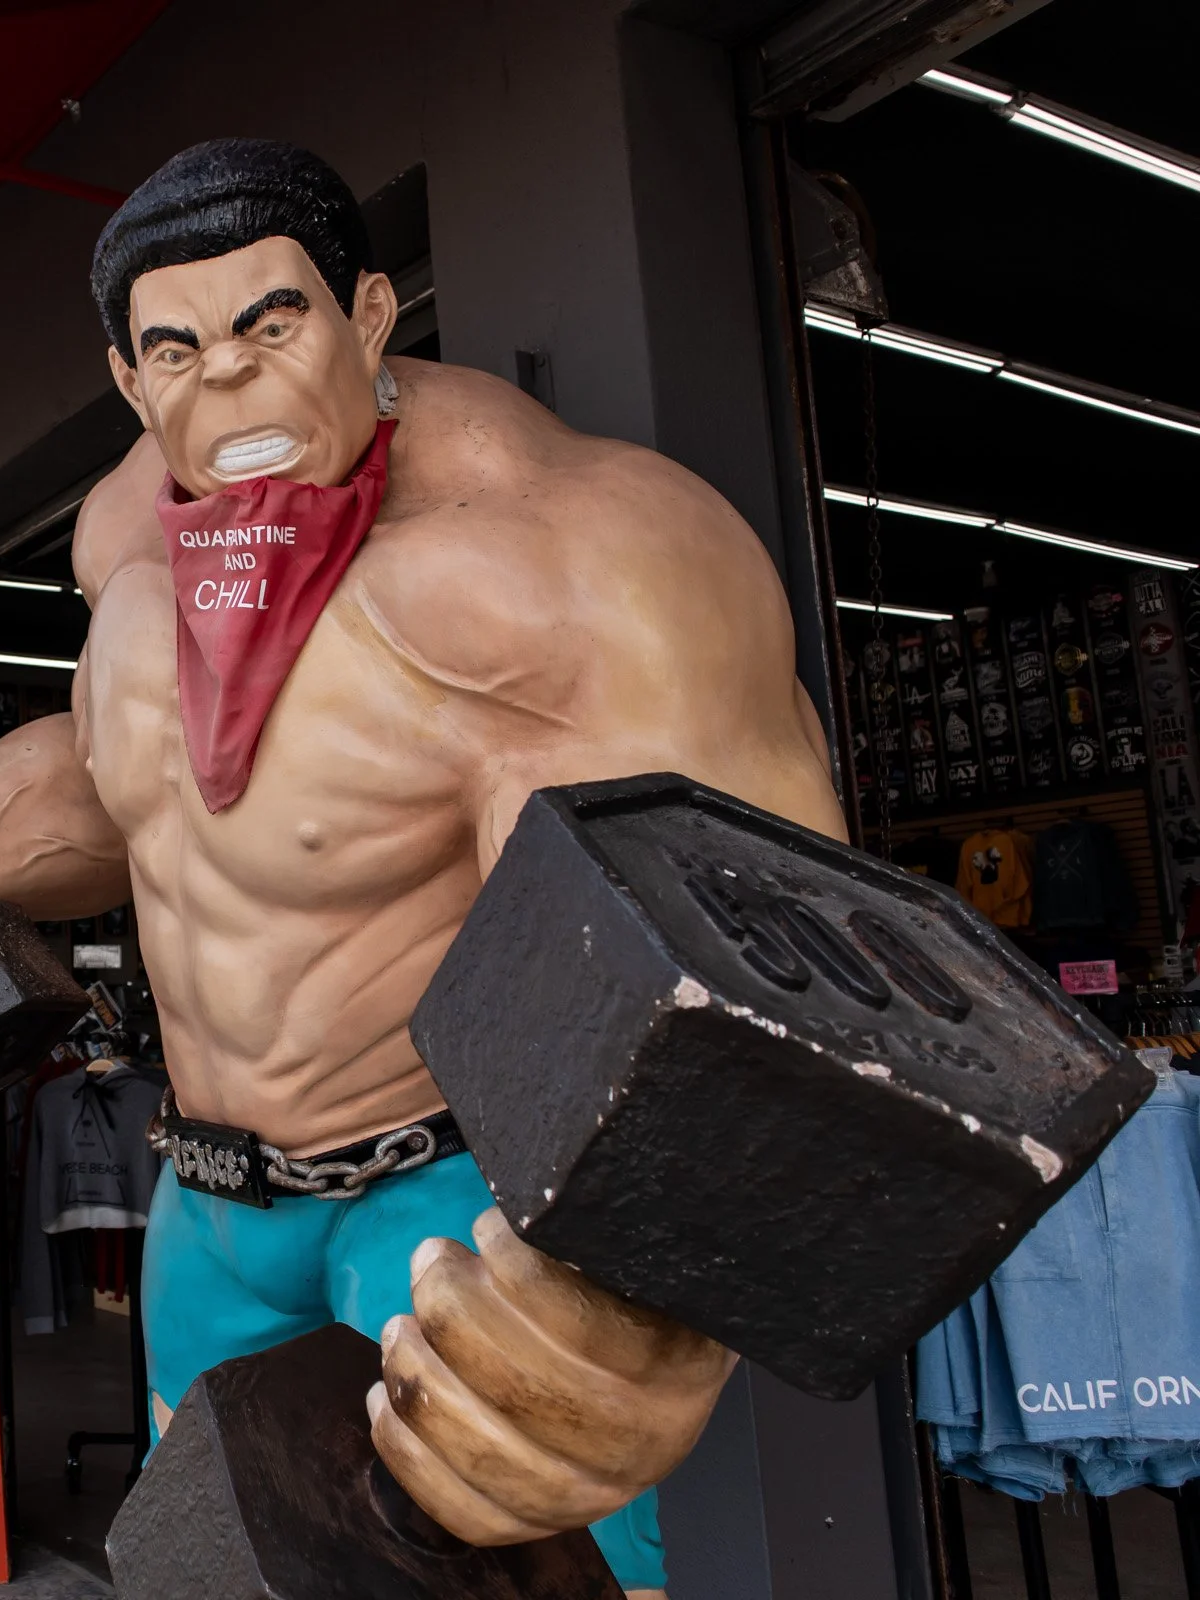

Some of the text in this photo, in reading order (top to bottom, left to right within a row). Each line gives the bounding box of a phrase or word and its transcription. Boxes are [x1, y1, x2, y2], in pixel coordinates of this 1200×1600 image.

[224, 552, 257, 571] AND
[194, 579, 270, 610] CHILL
[683, 874, 973, 1023] 500
[89, 1162, 129, 1176] BEACH
